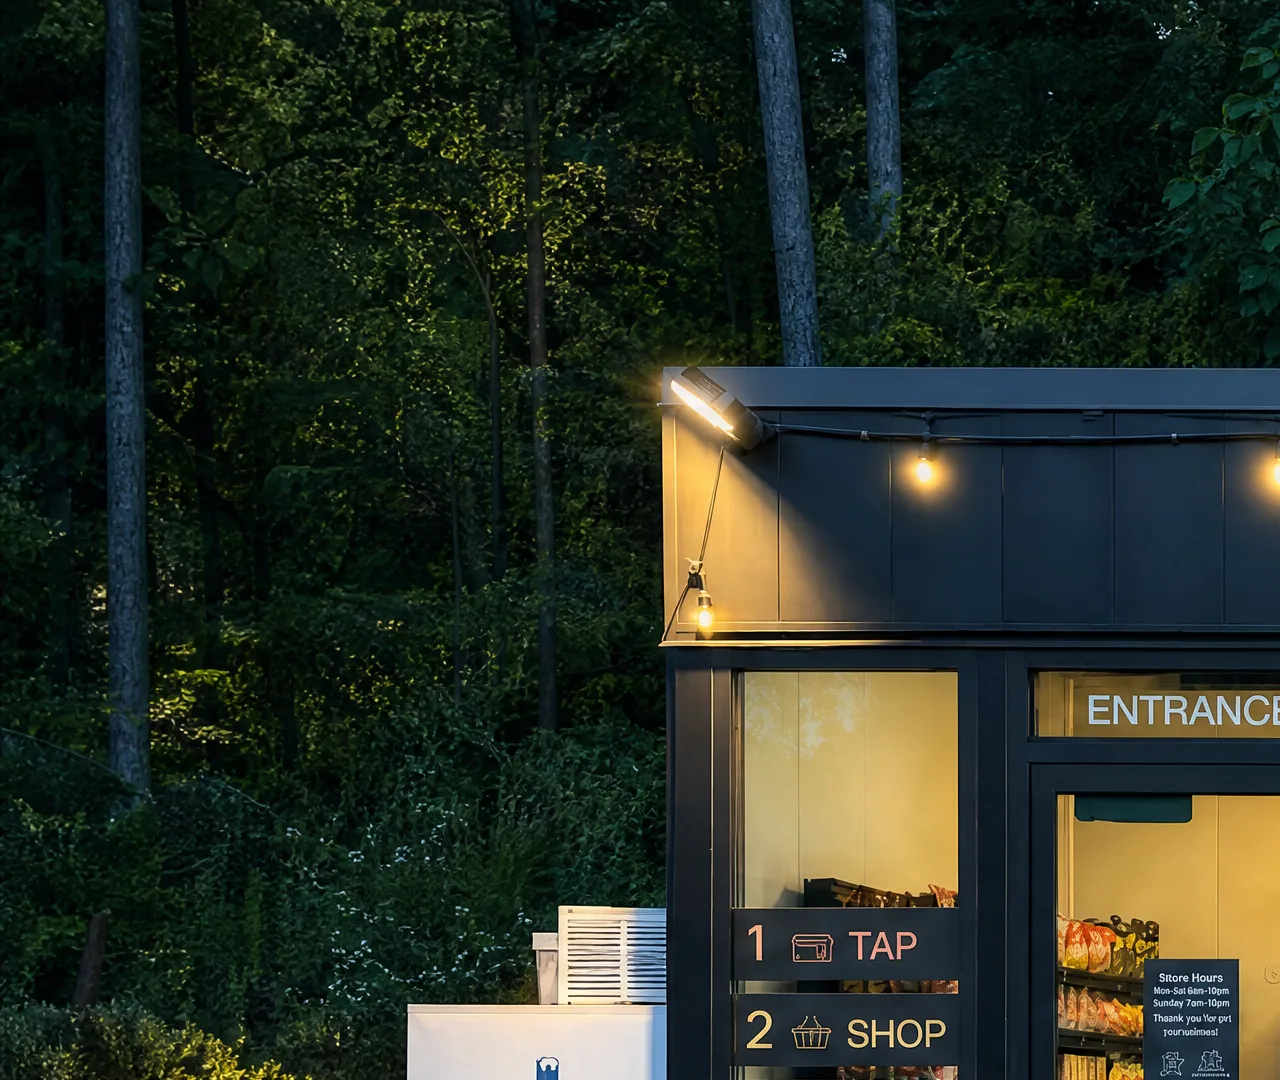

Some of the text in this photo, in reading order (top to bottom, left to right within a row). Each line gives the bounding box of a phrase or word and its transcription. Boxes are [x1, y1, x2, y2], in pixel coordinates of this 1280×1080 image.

[748, 924, 918, 961] 1 TAP
[1192, 973, 1224, 983] Hours
[1153, 999, 1184, 1009] Sunday
[1186, 1015, 1202, 1026] you
[746, 1009, 947, 1049] 2 SHOP
